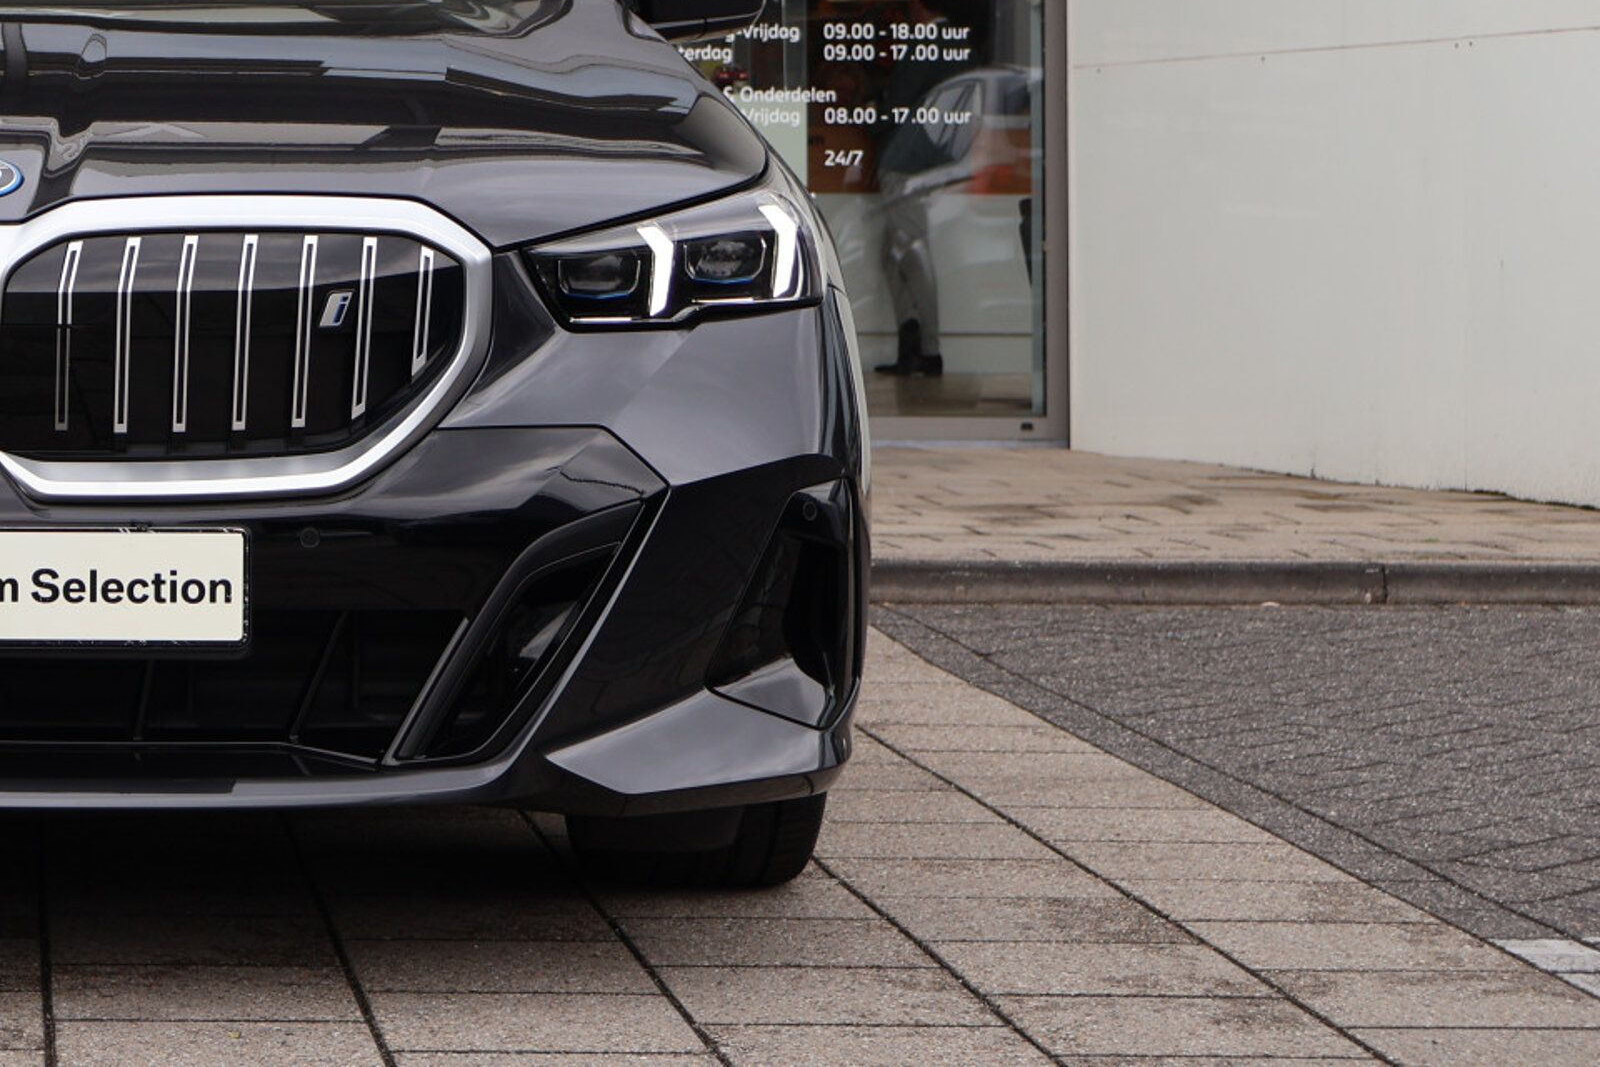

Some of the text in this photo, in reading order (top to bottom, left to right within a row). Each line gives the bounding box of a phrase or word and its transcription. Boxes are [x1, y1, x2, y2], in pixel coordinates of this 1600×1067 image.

[823, 23, 875, 40] 09.00
[890, 23, 938, 40] 18.00
[942, 27, 970, 40] uur
[823, 44, 875, 61] 09.00
[942, 48, 971, 61] uur
[740, 86, 837, 103] Onderdelen
[824, 107, 876, 124] 08.00
[944, 111, 972, 124] uur
[824, 150, 864, 166] 24/7
[30, 568, 234, 604] Selection
